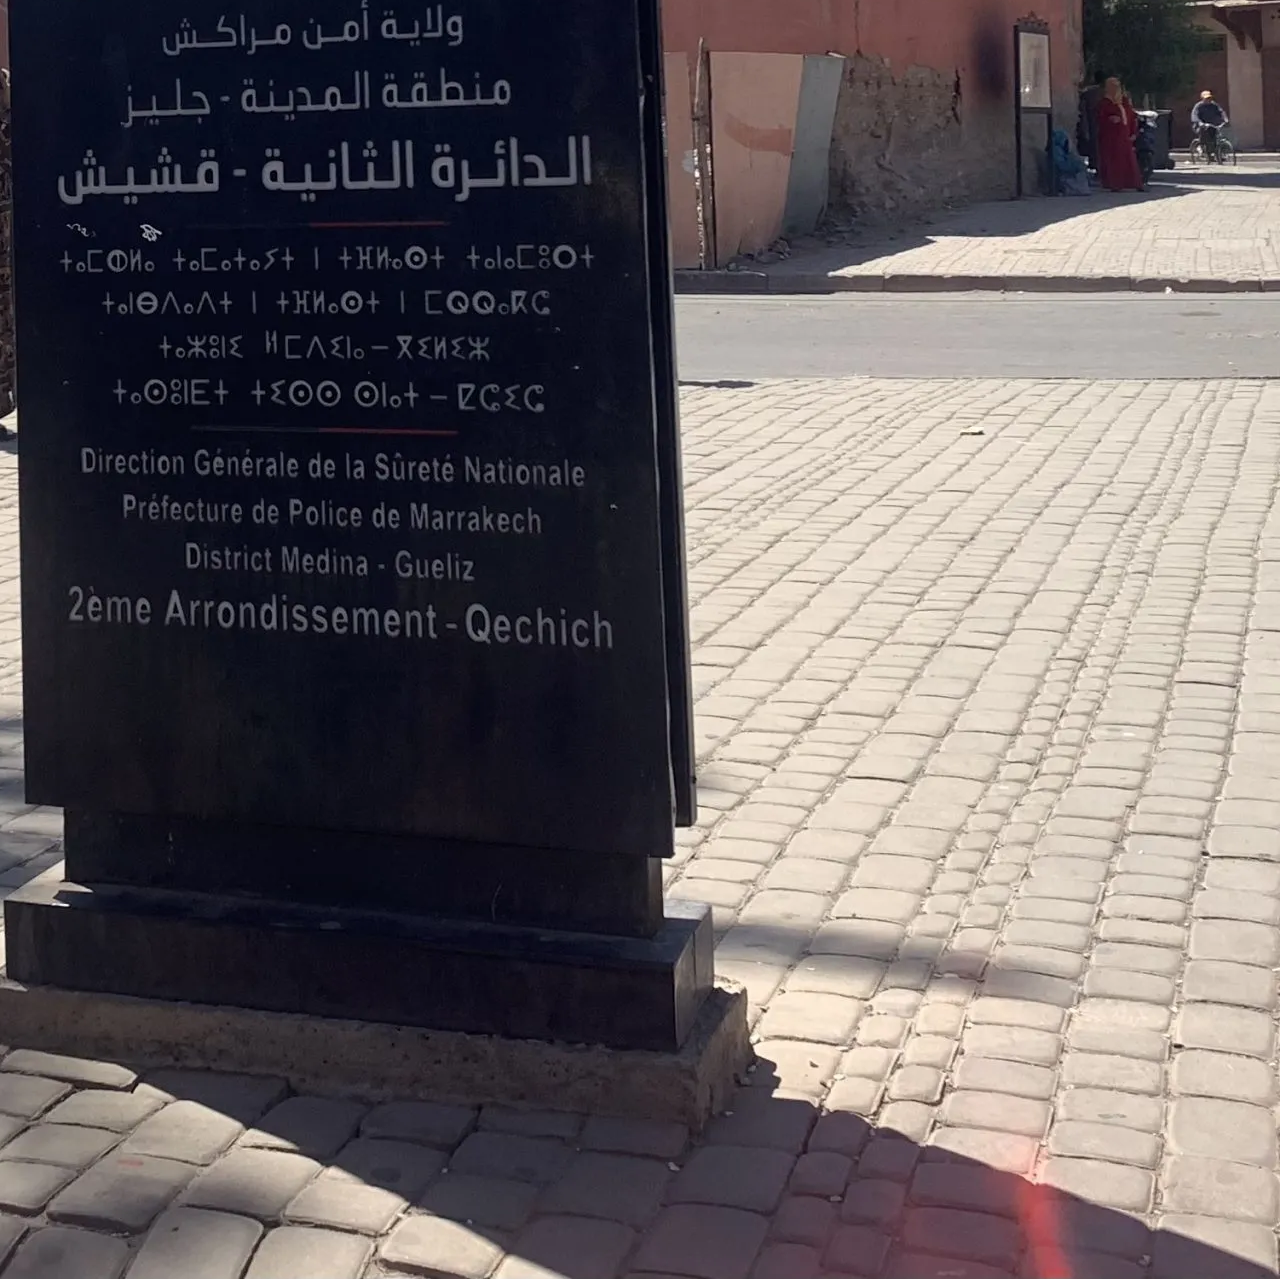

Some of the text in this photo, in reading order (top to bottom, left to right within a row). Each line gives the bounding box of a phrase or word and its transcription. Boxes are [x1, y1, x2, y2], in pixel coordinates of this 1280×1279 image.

[162, 14, 292, 56] مراكش
[380, 4, 464, 47] ولاية
[120, 77, 211, 129] جليز
[241, 70, 370, 121] المدينة
[382, 67, 511, 108] منطقة
[57, 146, 220, 205] قشيش
[261, 139, 415, 203] الثانية
[431, 134, 592, 202] الدائرة
[81, 447, 585, 487] Direction Générale de la Sûreté Nationale
[123, 493, 542, 534] Préfecture de Police de Marrakech
[185, 542, 272, 572] District
[281, 545, 368, 576] Medina
[395, 549, 475, 581] Gueliz
[68, 585, 151, 624] 2ème
[164, 589, 438, 639] Arrondissement
[465, 603, 613, 649] Qechich
